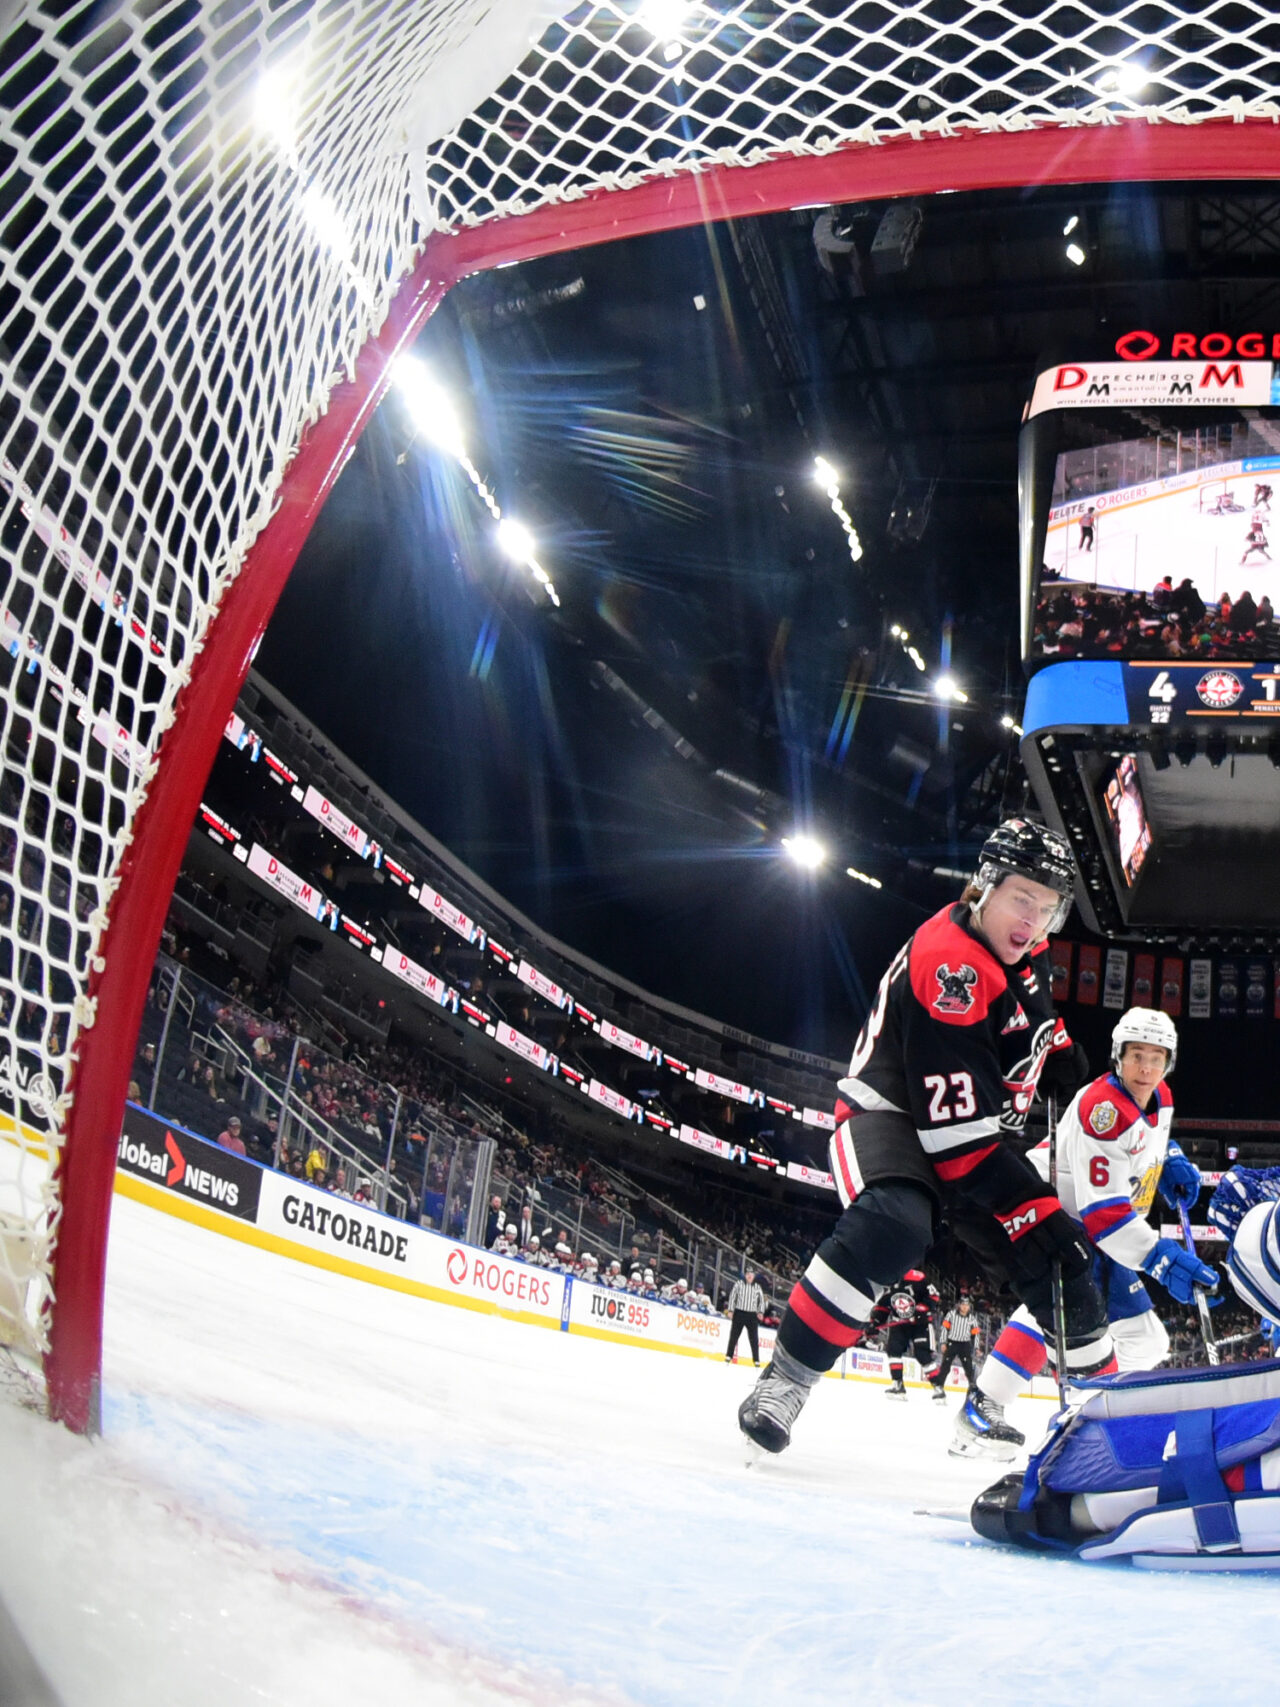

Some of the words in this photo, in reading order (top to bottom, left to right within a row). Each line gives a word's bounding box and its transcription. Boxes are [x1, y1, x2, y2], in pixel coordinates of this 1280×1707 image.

[1187, 396, 1236, 404] FATHERS
[1108, 486, 1148, 506] ROGERS
[1148, 671, 1177, 703] 4
[1151, 712, 1170, 723] 22
[1041, 861, 1069, 877] CCM
[923, 1071, 978, 1122] 23
[184, 1163, 240, 1207] NEWS
[1089, 1155, 1110, 1188] 6
[282, 1194, 409, 1263] GATORADE
[472, 1258, 551, 1306] ROGERS
[590, 1294, 626, 1322] IUOE
[627, 1304, 651, 1328] 955
